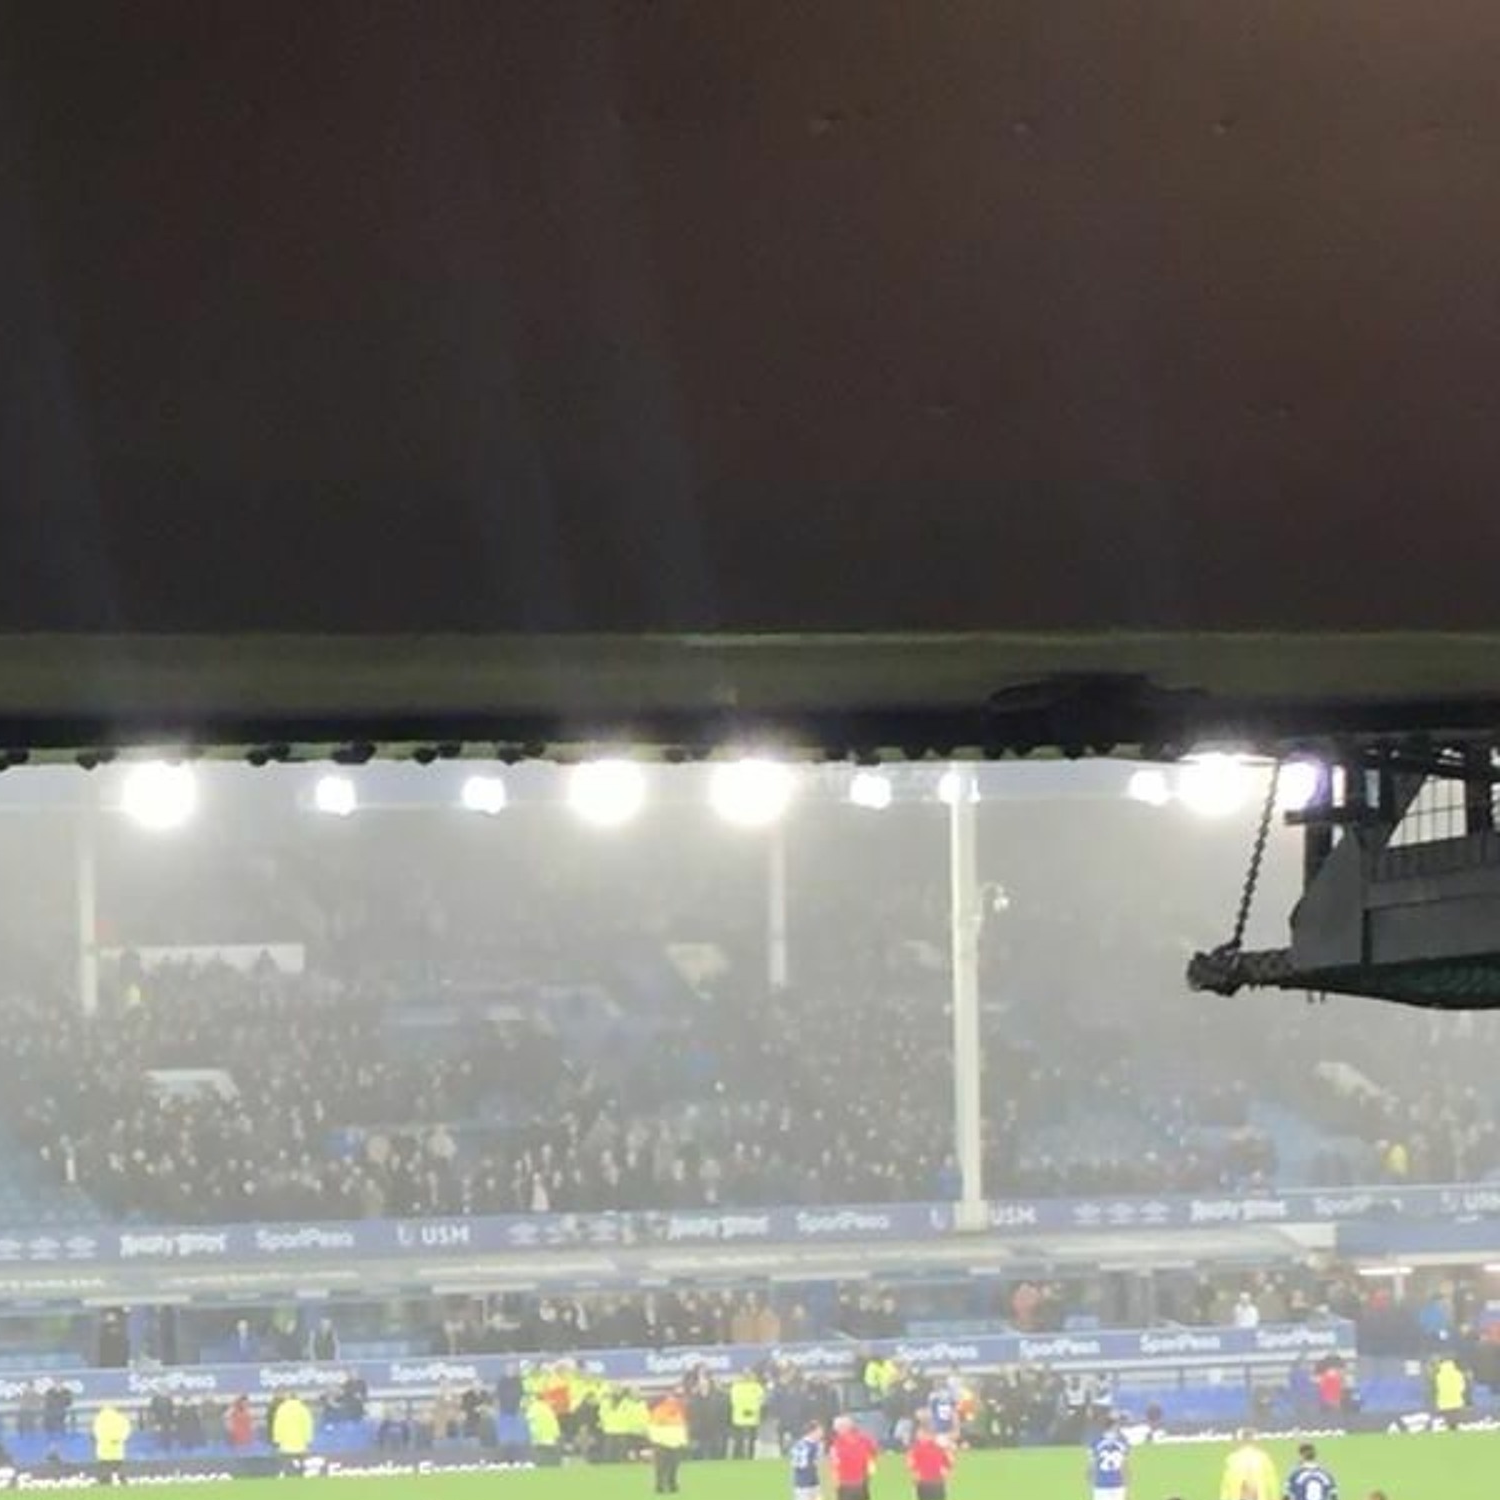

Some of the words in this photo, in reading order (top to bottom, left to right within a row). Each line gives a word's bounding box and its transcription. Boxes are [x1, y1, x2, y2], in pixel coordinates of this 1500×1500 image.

[796, 1210, 891, 1231] SportPesa
[255, 1228, 354, 1250] SportPesa
[421, 1225, 470, 1244] USM
